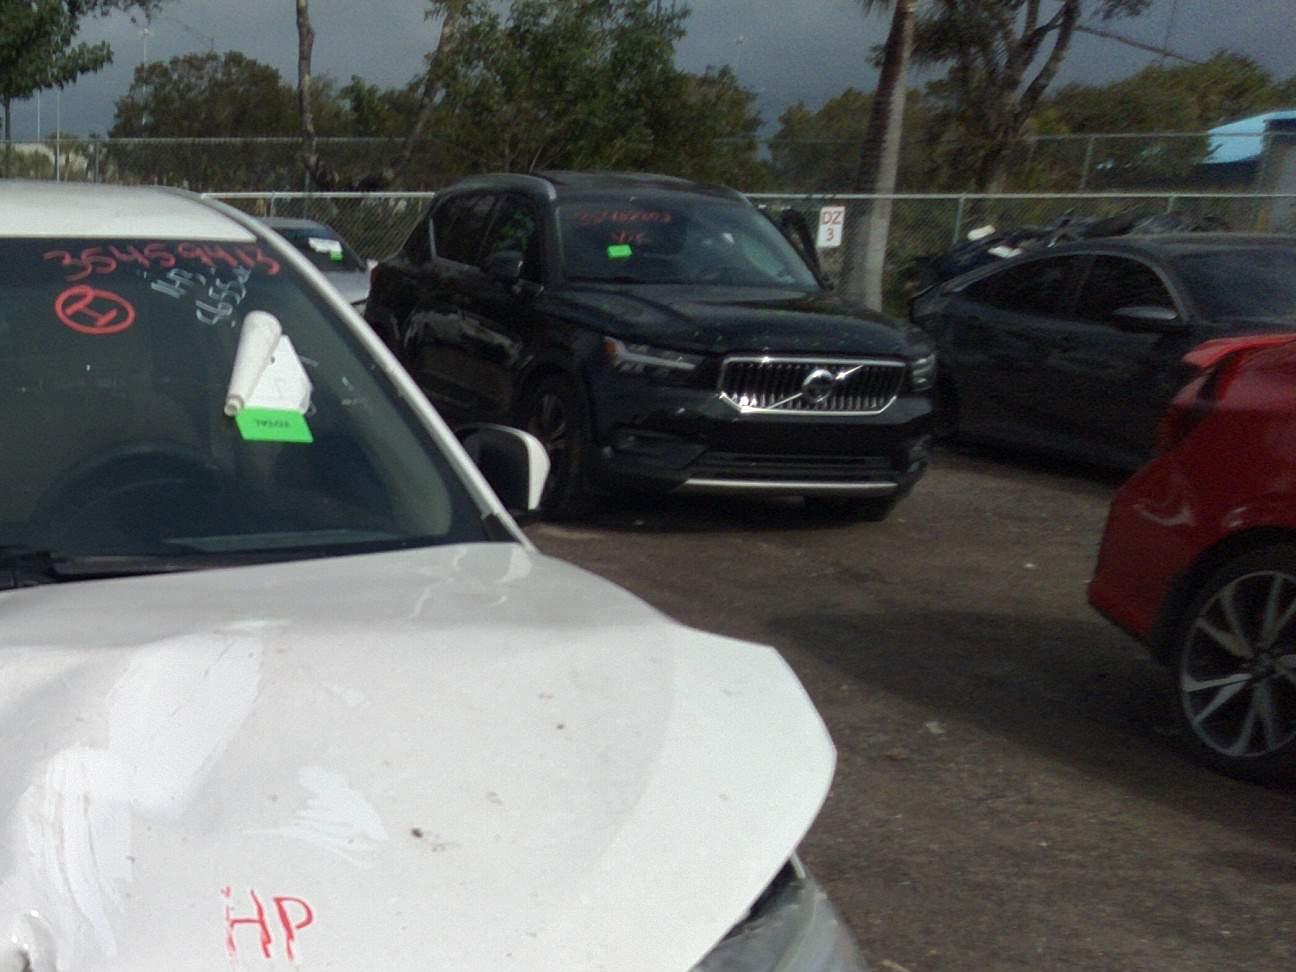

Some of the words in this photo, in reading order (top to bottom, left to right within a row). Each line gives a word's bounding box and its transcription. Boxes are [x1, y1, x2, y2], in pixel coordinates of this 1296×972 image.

[822, 210, 842, 225] DZ
[826, 227, 834, 241] 3
[220, 885, 314, 962] HP
